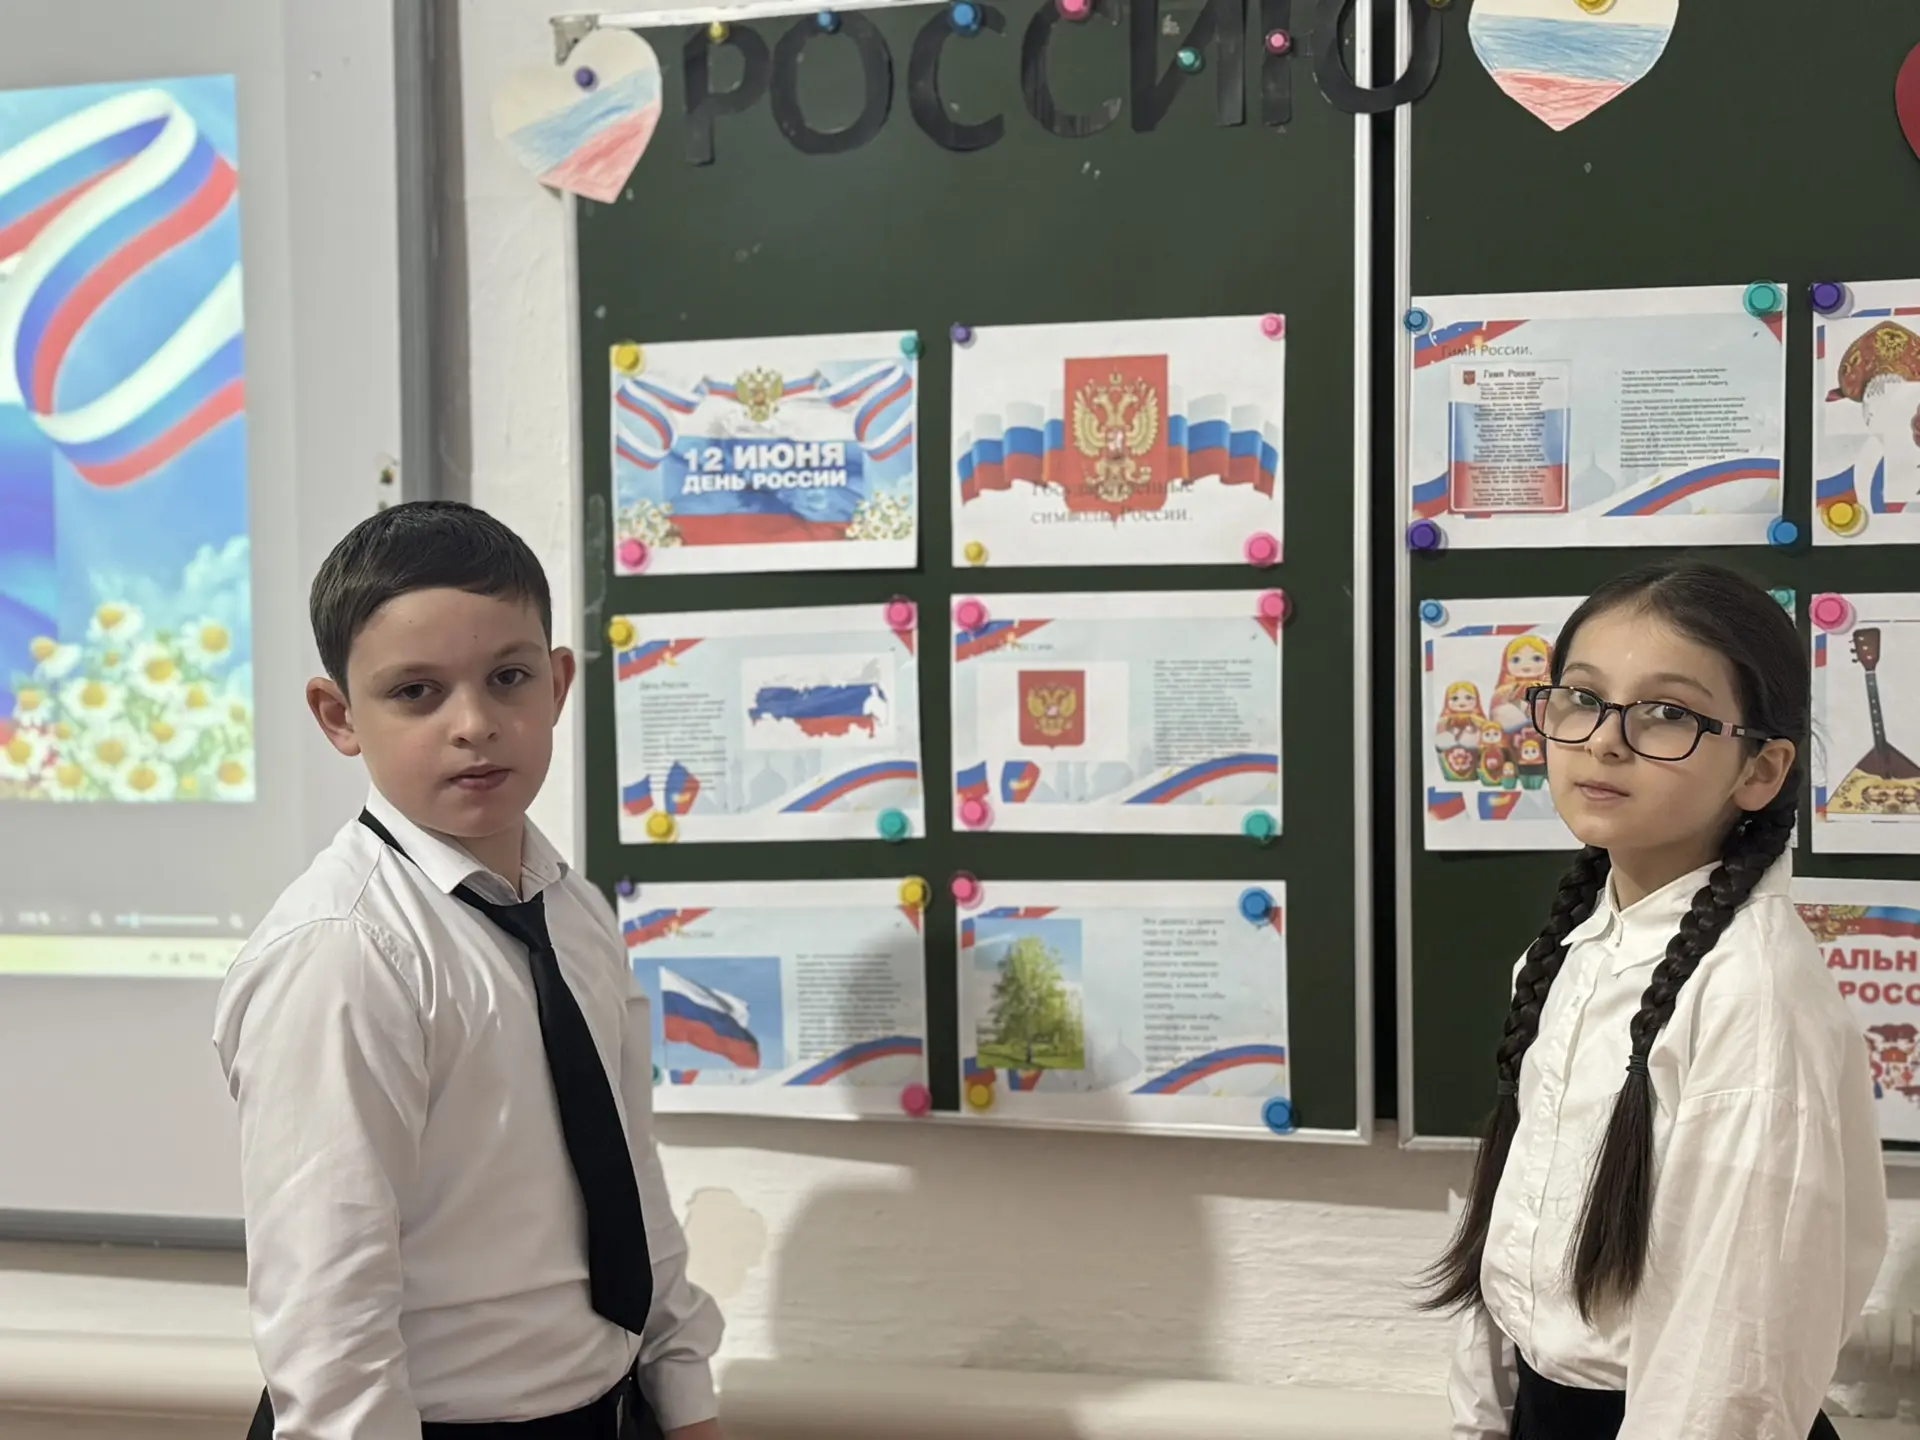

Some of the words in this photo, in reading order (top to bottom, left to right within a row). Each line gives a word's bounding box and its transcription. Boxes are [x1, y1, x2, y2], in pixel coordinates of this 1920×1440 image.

[682, 0, 1442, 166] РОССИЮ
[682, 448, 723, 472] 12
[734, 442, 845, 470] ИЮНЯ
[681, 474, 745, 495] ДЕНЬ
[753, 469, 847, 490] РОССИИ
[1818, 946, 1918, 973] АЛЬН
